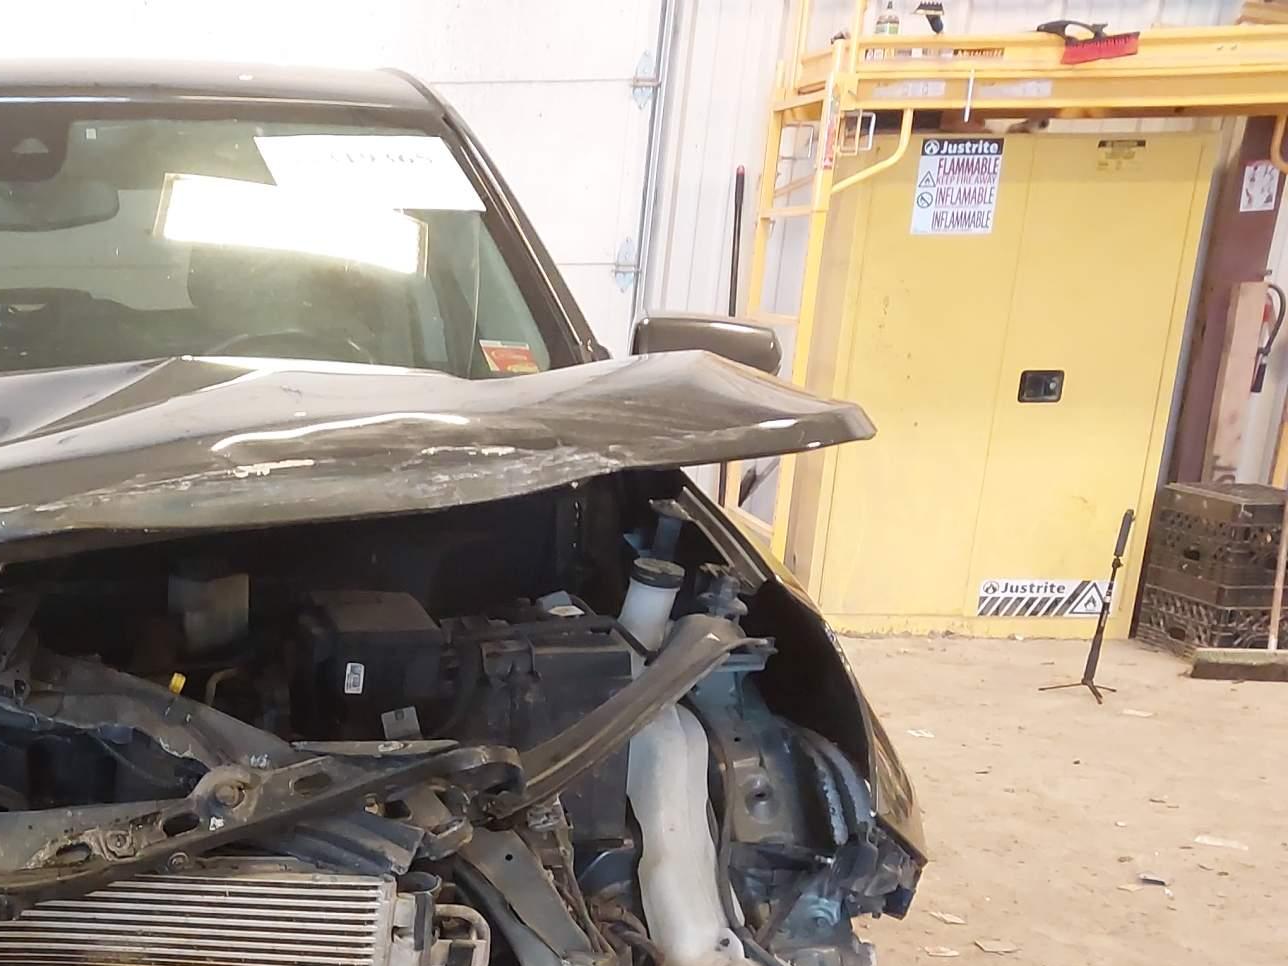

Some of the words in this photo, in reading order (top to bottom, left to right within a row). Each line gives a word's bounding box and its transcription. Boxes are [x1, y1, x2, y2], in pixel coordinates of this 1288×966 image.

[940, 139, 999, 154] Justrite
[937, 157, 1000, 175] FLAMMABLE
[935, 187, 995, 206] INFLAMABLE
[931, 210, 992, 231] INFLAMMABLE
[1000, 581, 1066, 594] Justrite
